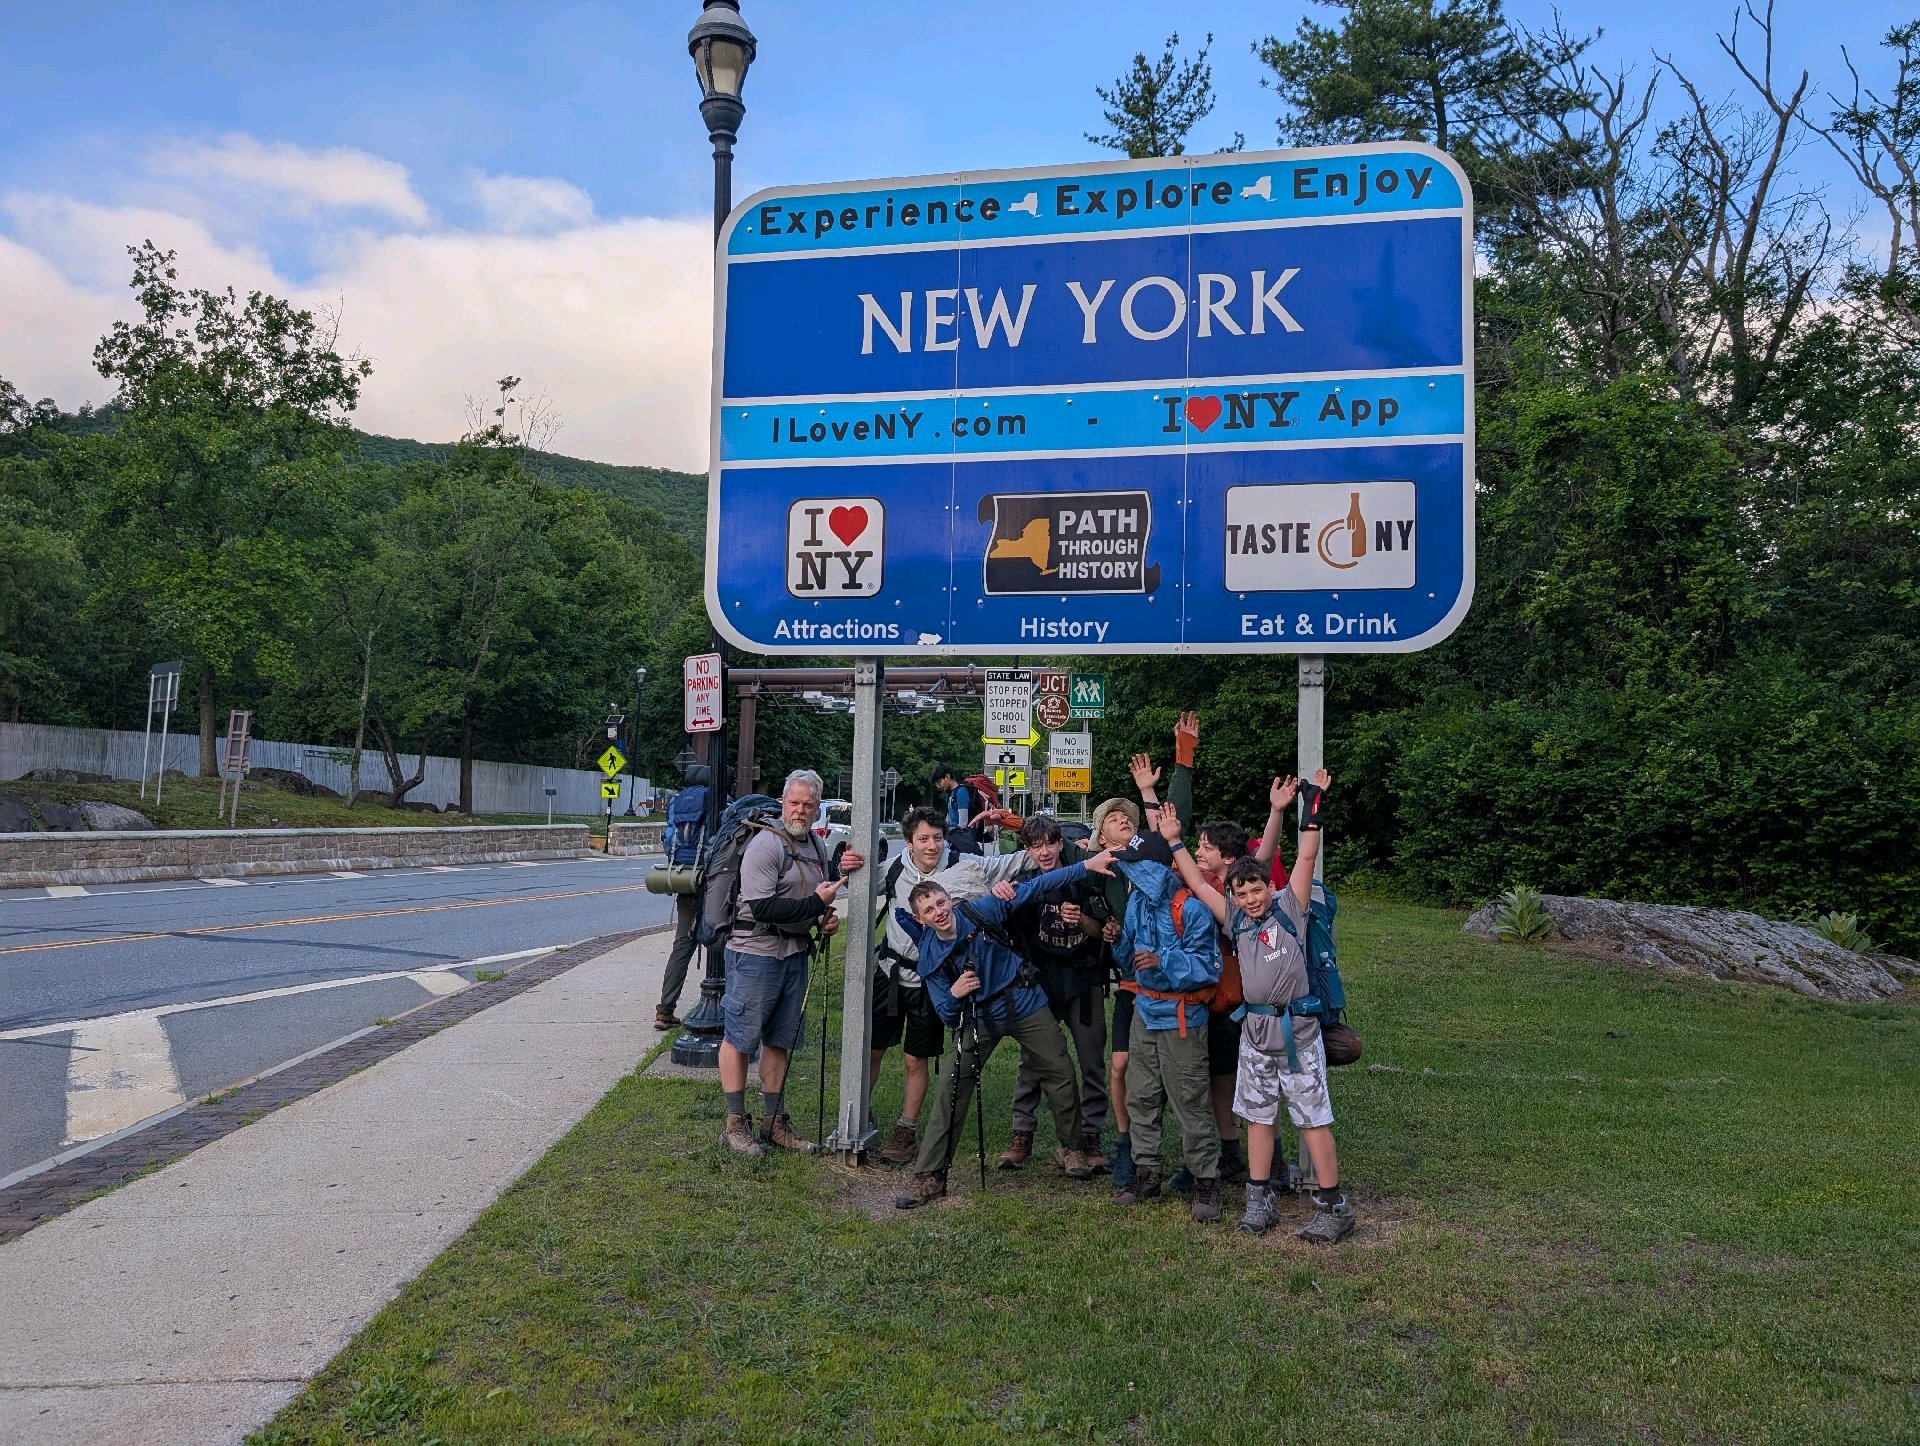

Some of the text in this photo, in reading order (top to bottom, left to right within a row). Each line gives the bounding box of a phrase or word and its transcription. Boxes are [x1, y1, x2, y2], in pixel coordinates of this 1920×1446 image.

[760, 163, 1433, 240] Experience Explore Enjoy
[858, 268, 1304, 355] NEW YORK
[1318, 394, 1399, 427] App
[804, 508, 824, 546] I
[1058, 508, 1138, 535] PATH
[1227, 520, 1414, 554] TASTE NY
[1059, 539, 1138, 555] THROUGH
[1059, 561, 1138, 579] HISTORY
[773, 619, 899, 639] Attractions
[1021, 617, 1109, 642] History
[1241, 613, 1397, 635] Eat & Drink
[696, 660, 709, 675] NO
[688, 676, 719, 692] PARKING
[988, 686, 1029, 695] STOP FOR
[1041, 675, 1068, 692] JCT
[696, 693, 710, 703] ANY
[989, 698, 1028, 709] STOPPED
[696, 706, 711, 716] TIME
[991, 711, 1026, 722] SCHOOL
[999, 724, 1017, 734] BUS
[1064, 737, 1077, 746] NO
[1052, 748, 1075, 756] TRUCKS
[1055, 758, 1084, 766] TRAILERS
